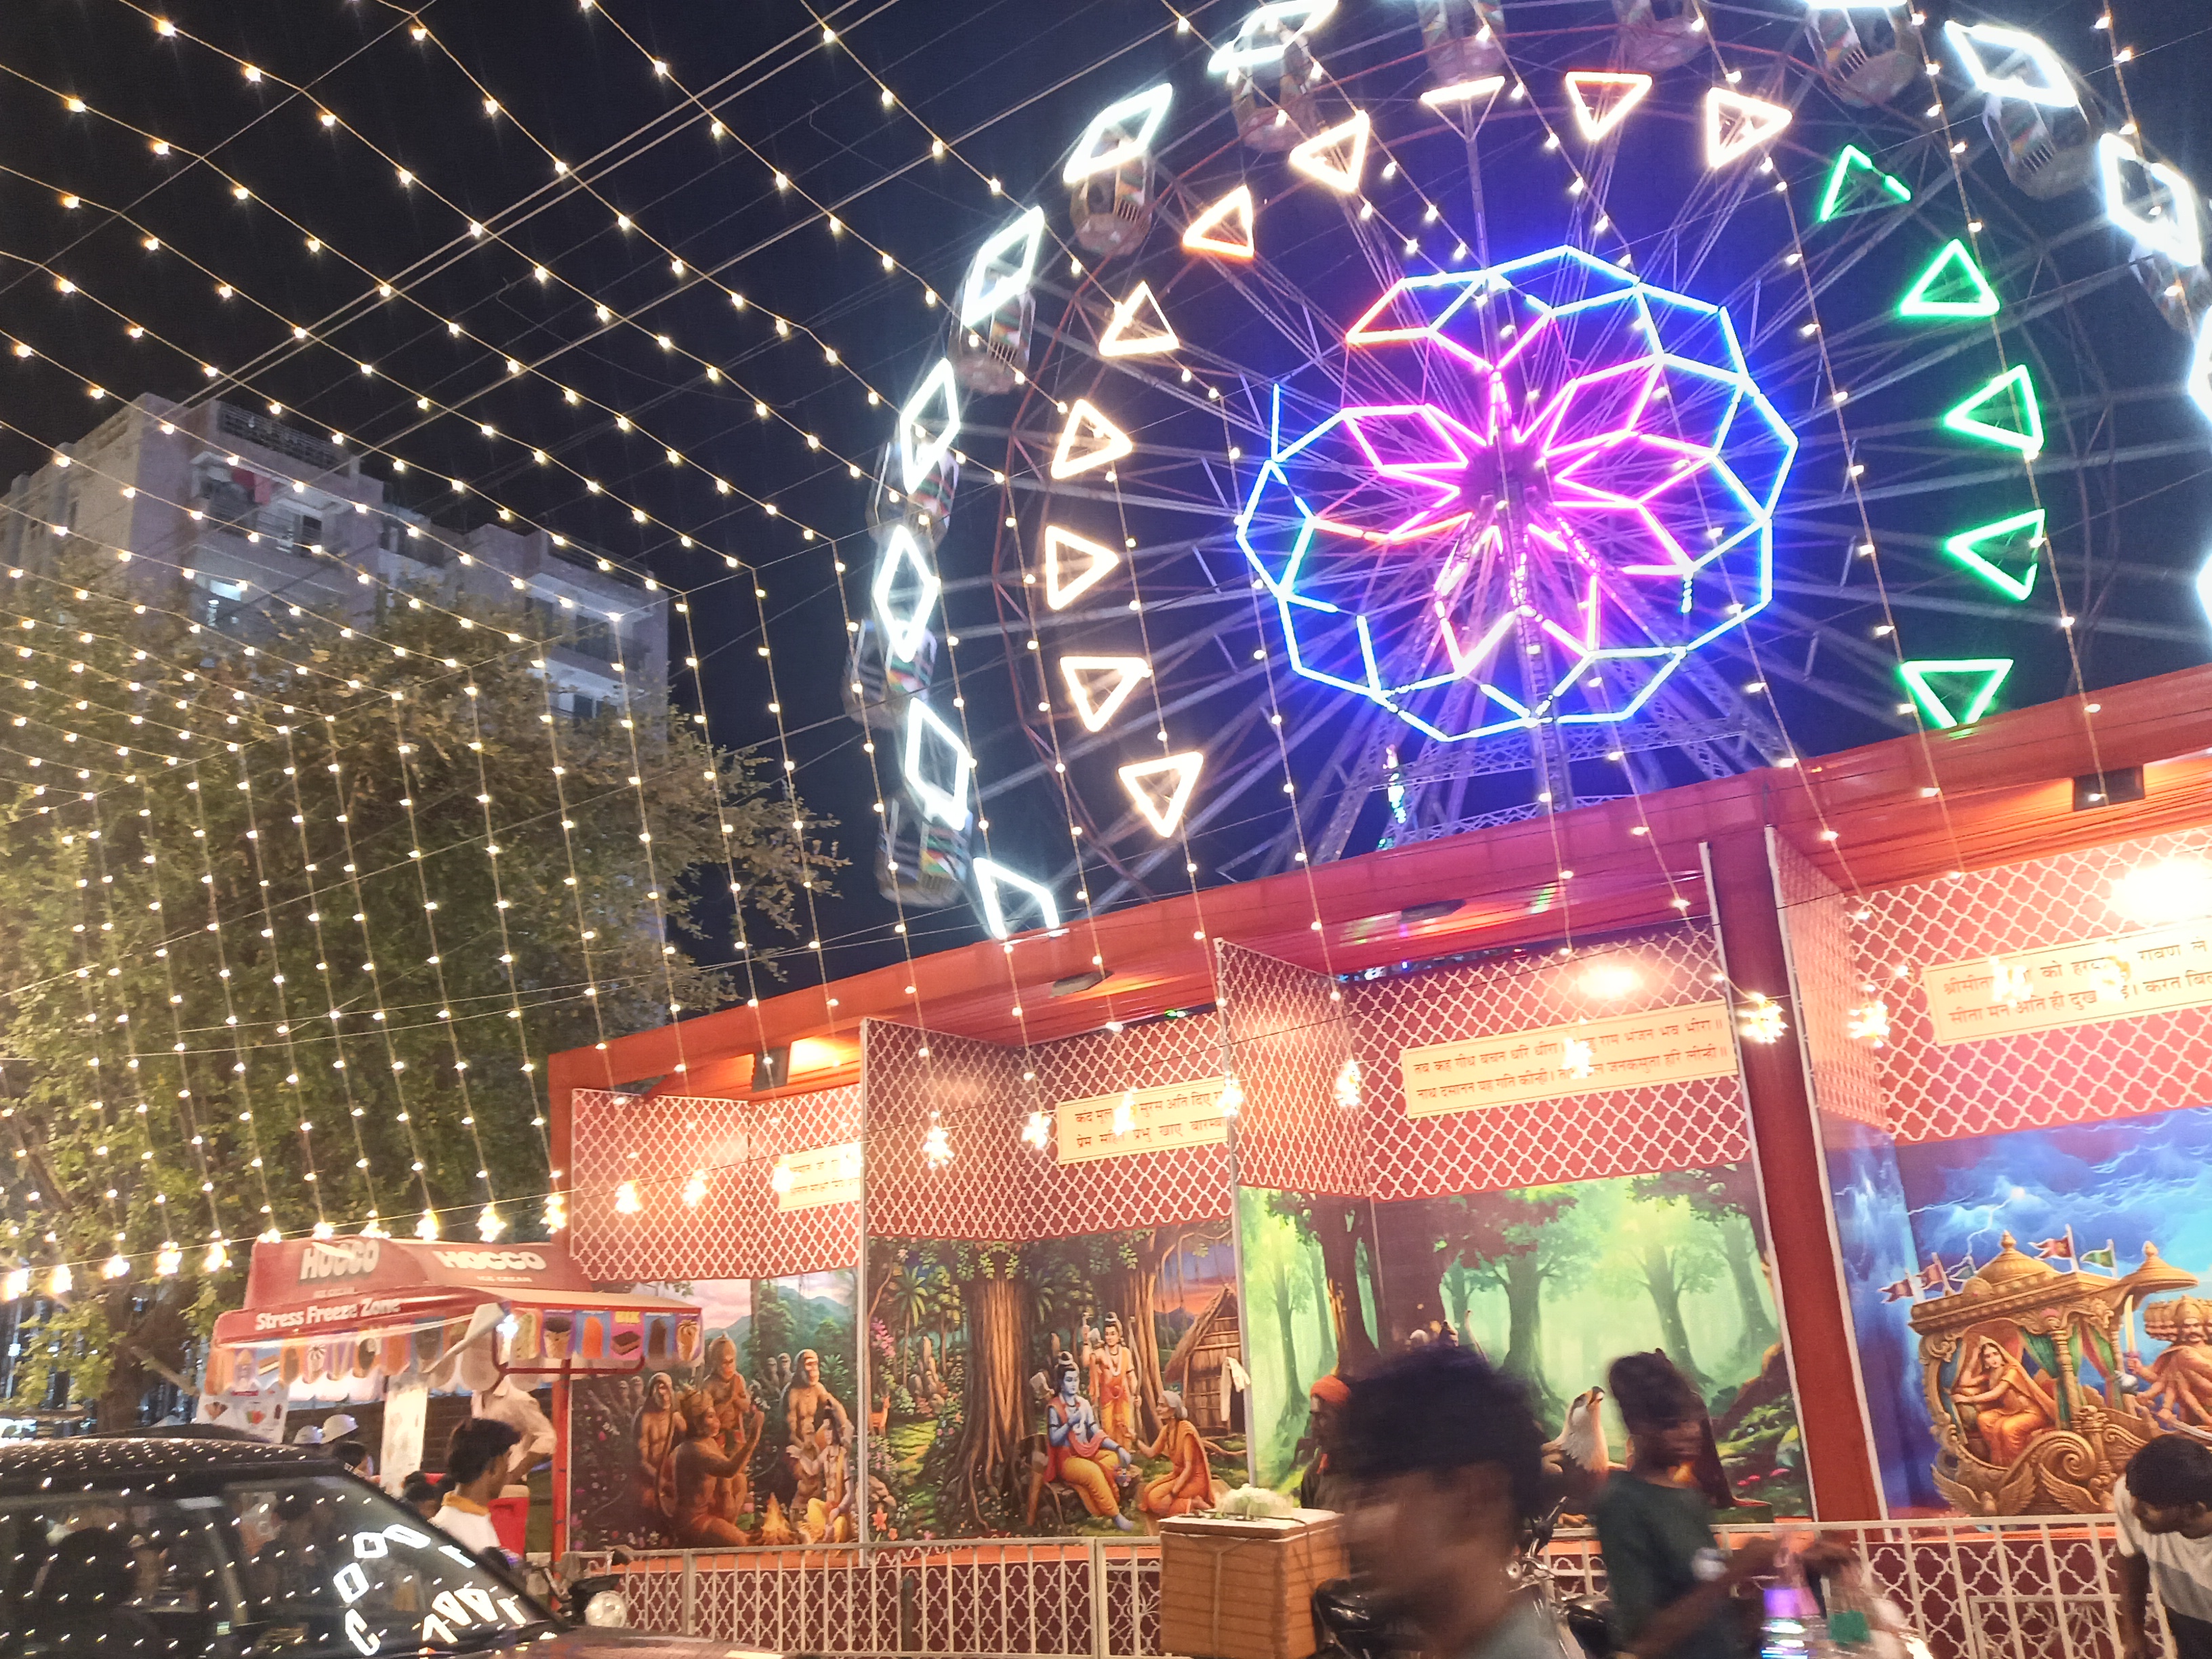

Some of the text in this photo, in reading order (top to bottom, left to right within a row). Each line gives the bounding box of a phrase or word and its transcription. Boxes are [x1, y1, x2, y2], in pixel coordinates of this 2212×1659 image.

[2040, 960, 2063, 978] को
[2137, 944, 2181, 960] रावण
[1948, 1006, 1984, 1024] सीता
[1986, 1003, 2011, 1019] मन
[2016, 994, 2047, 1014] अति
[2049, 991, 2066, 1010] ही
[2068, 990, 2097, 1010] दुख
[2142, 976, 2182, 994] करत
[1599, 1034, 1619, 1047] राम
[1166, 1093, 1188, 1109] अति
[432, 1250, 548, 1271] HOCCO
[254, 1297, 402, 1332] Stress Freeze Zone
